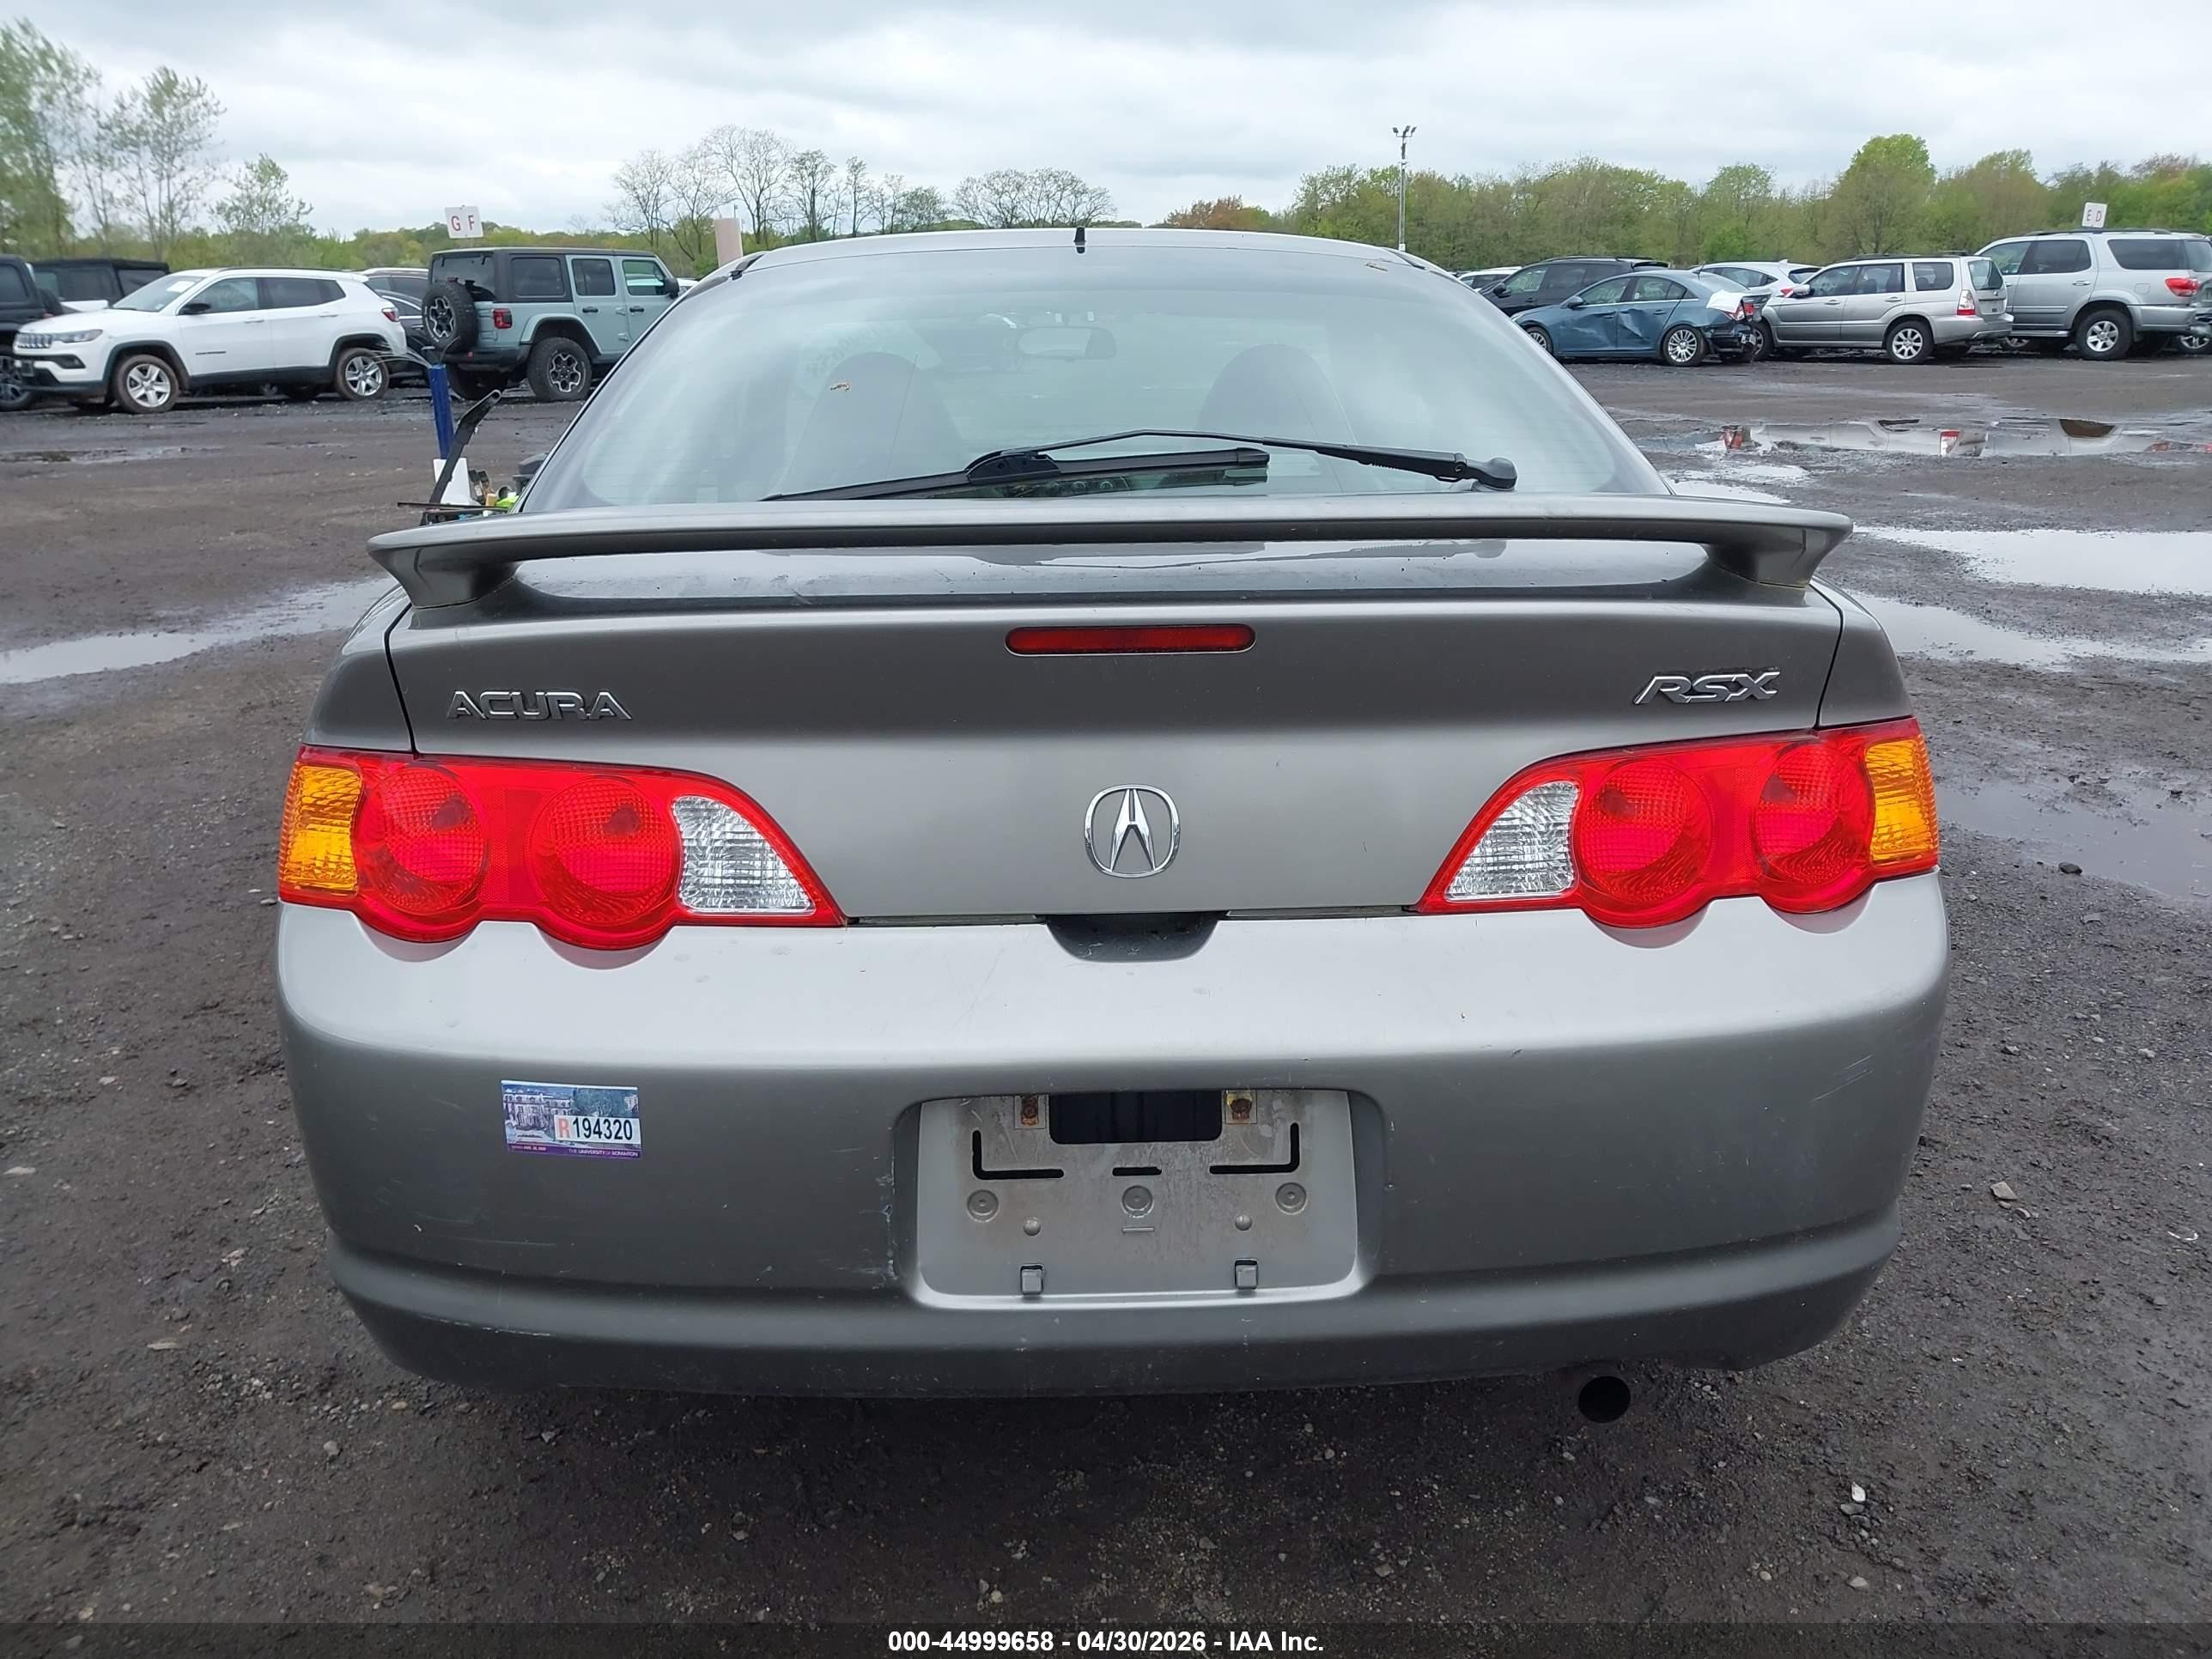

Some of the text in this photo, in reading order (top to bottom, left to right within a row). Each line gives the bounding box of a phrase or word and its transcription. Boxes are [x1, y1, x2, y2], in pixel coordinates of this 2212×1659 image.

[451, 214, 475, 232] G F
[2087, 210, 2093, 222] E
[1633, 670, 1781, 704] RSX
[447, 690, 633, 720] ACURA
[572, 1117, 633, 1140] 194320
